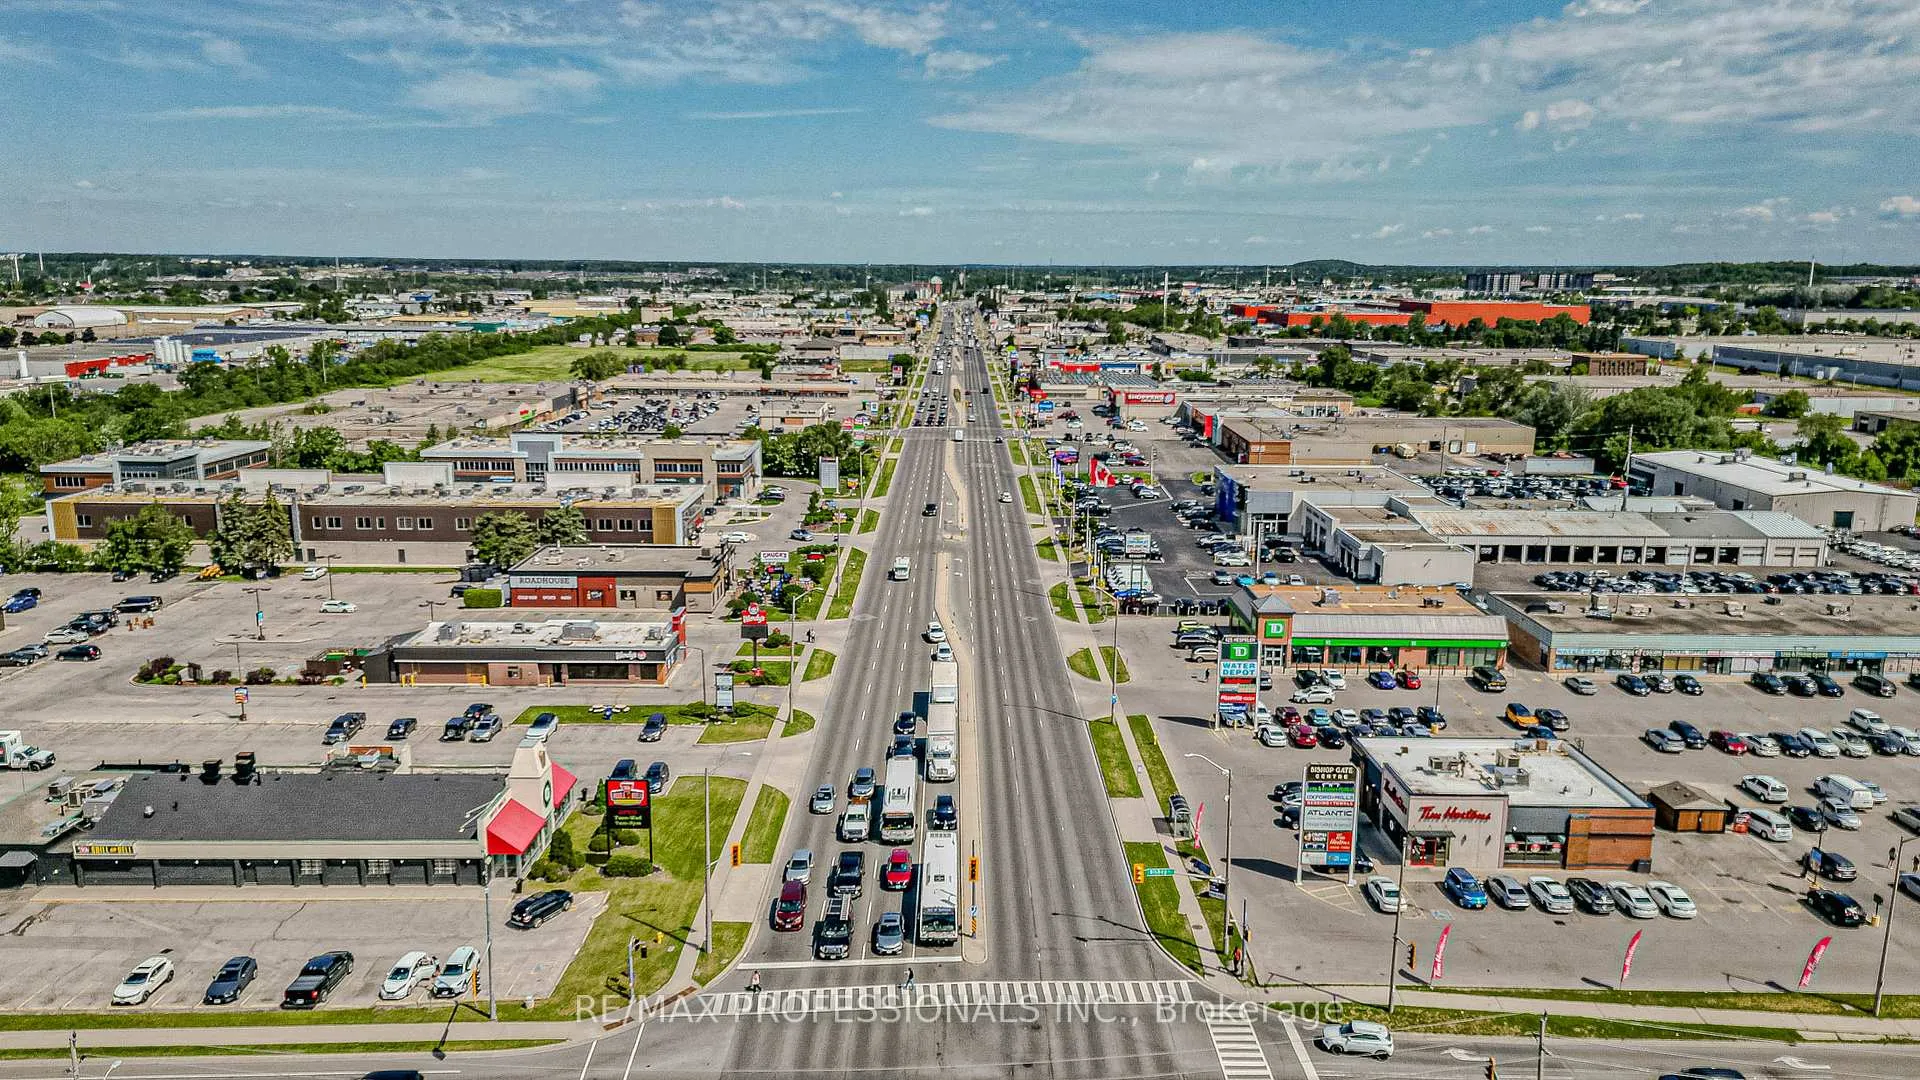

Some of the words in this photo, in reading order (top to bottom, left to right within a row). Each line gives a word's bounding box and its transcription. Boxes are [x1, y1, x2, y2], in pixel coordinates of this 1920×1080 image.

[520, 577, 570, 585] ROADHOUSE
[1310, 766, 1334, 774] BISHOP
[1335, 766, 1353, 774] GATE
[1418, 806, 1442, 821] Tim
[1442, 805, 1492, 821] Hortons
